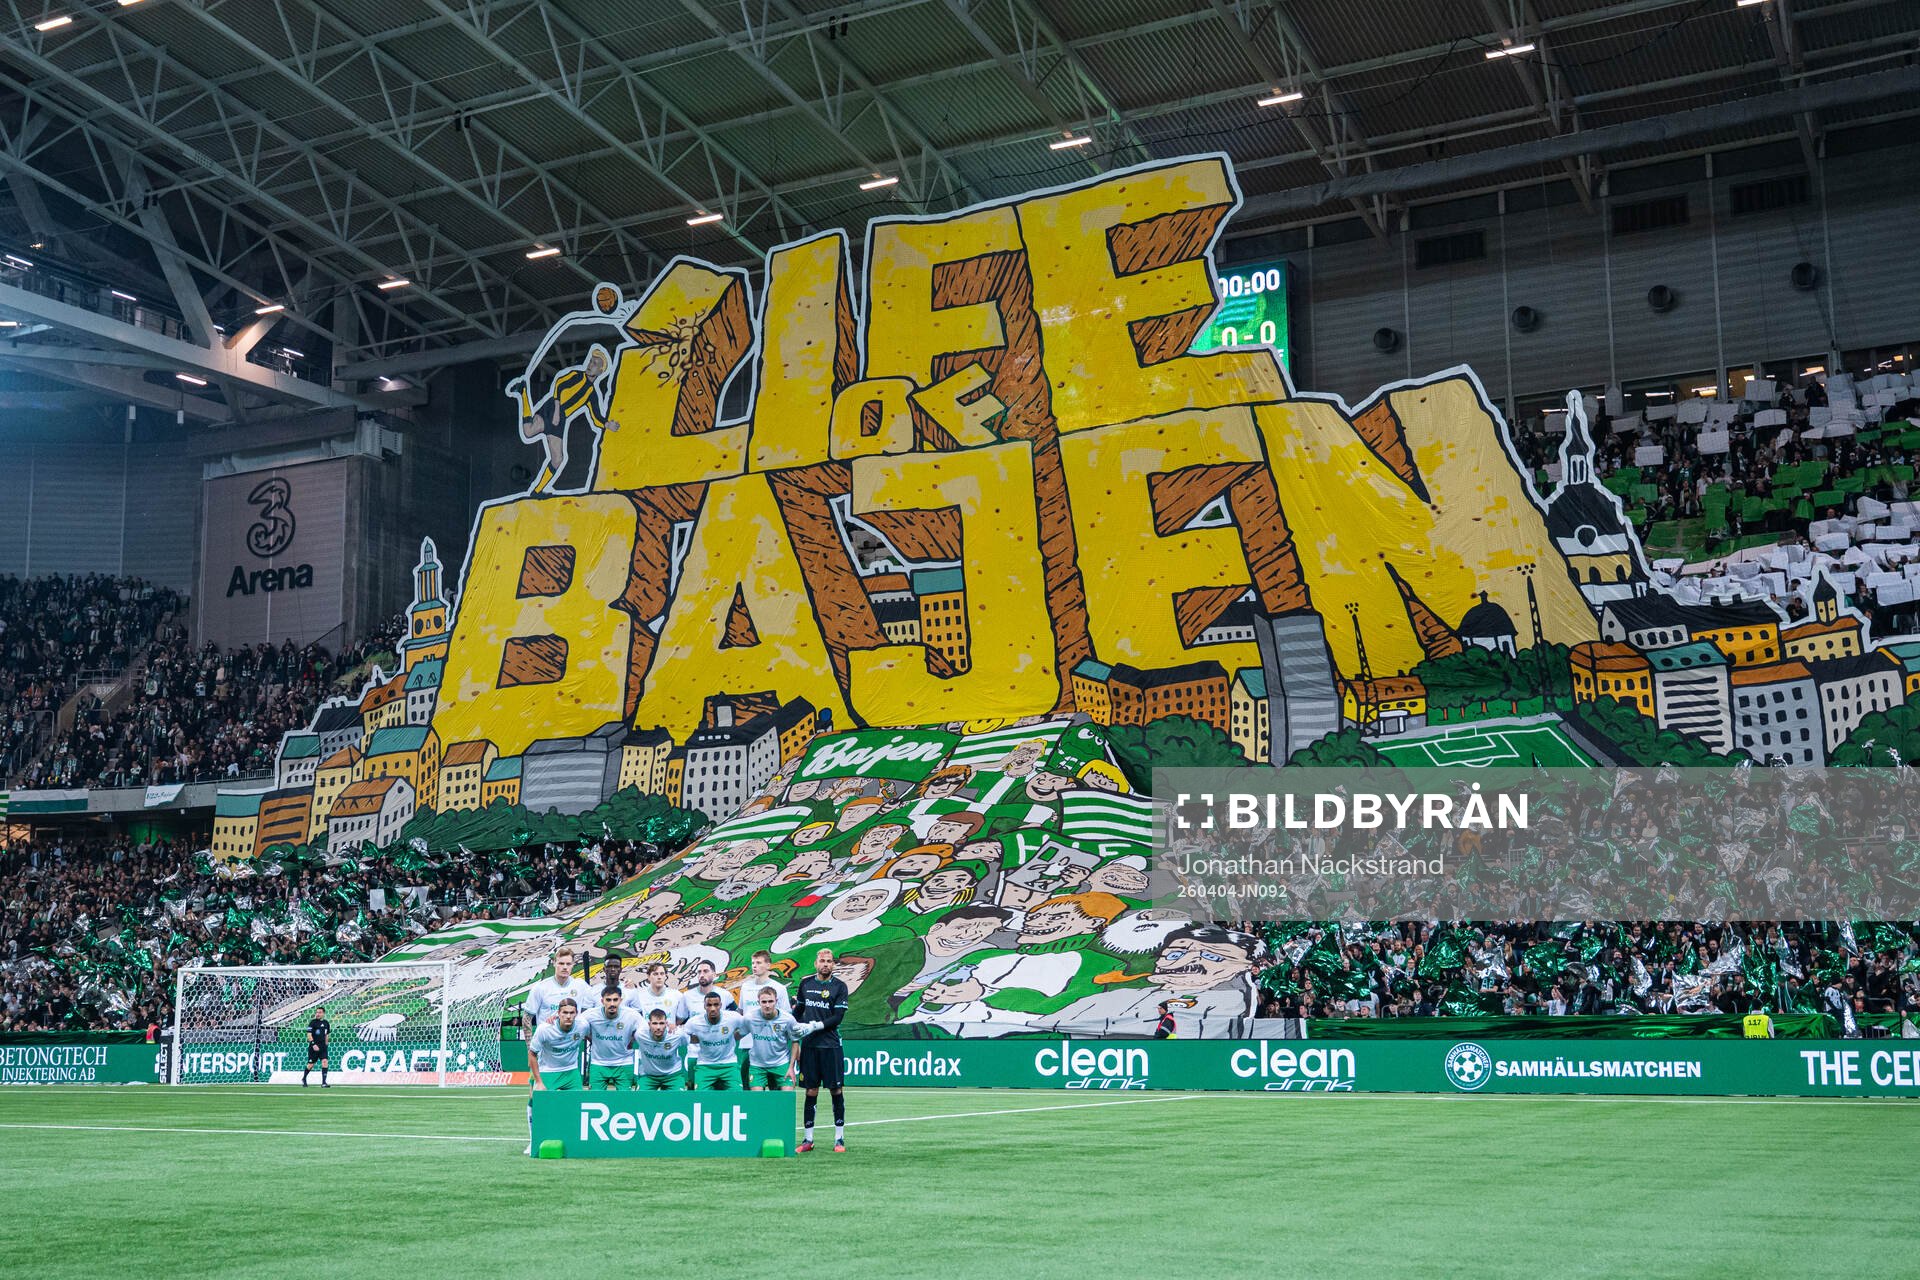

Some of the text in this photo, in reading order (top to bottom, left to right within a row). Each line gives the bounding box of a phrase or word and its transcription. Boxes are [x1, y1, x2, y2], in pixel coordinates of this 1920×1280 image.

[594, 156, 1293, 491] LIFE
[226, 563, 313, 597] Arena
[432, 374, 1600, 758] BAJEN
[802, 736, 943, 777] Bajen
[1016, 833, 1131, 864] HF
[805, 999, 830, 1009] Revolut
[596, 1033, 623, 1041] Revolut
[160, 1043, 168, 1084] SELECT
[183, 1052, 287, 1073] NTERSPORT
[340, 1050, 454, 1072] CRAFT
[843, 1051, 962, 1076] omPendax
[1035, 1040, 1149, 1076] clean
[1230, 1040, 1355, 1077] clean
[1495, 1056, 1701, 1077] SAMHÄLLSMATCHEN
[1800, 1051, 1862, 1085] THE
[2, 1067, 96, 1081] INJEKTERING AB
[1065, 1077, 1149, 1089] drink
[1264, 1079, 1356, 1091] drink
[580, 1102, 747, 1141] Revolut
